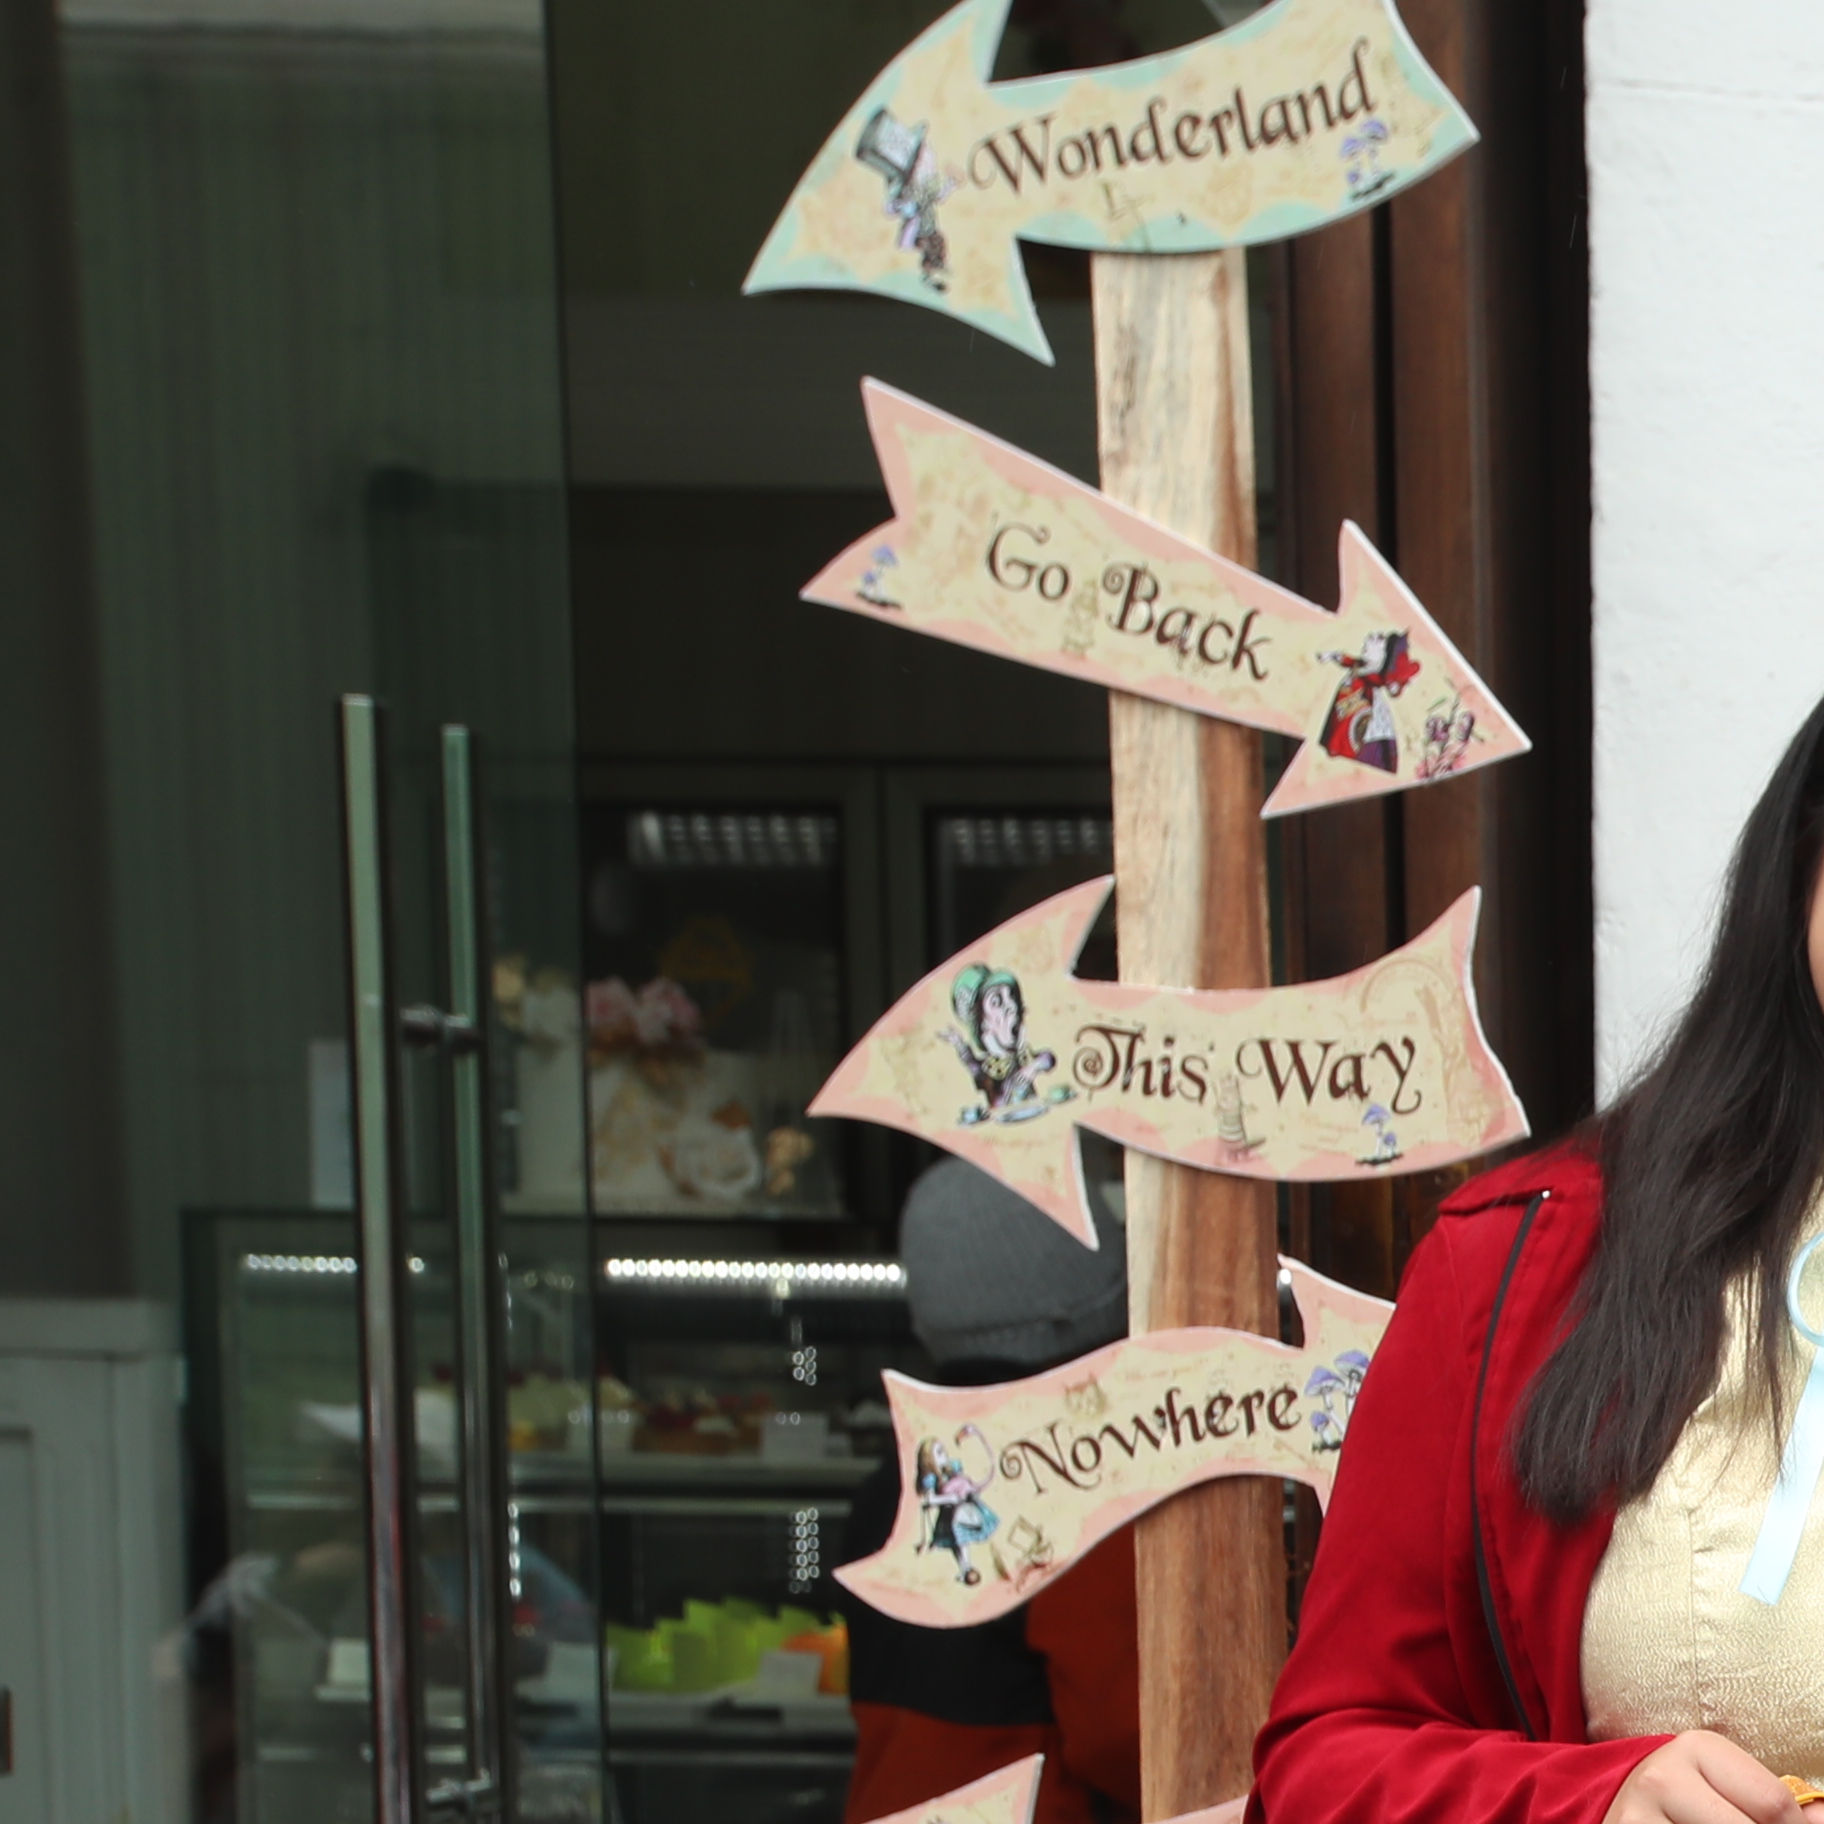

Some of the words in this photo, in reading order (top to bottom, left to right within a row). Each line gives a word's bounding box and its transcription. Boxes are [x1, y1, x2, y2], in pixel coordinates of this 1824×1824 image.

[967, 37, 1378, 196] Wonderland
[986, 521, 1069, 601] Go
[1102, 561, 1268, 681] Back
[1072, 1023, 1210, 1104] This
[1236, 1035, 1422, 1115] Way
[1000, 1387, 1300, 1496] Nowhere
